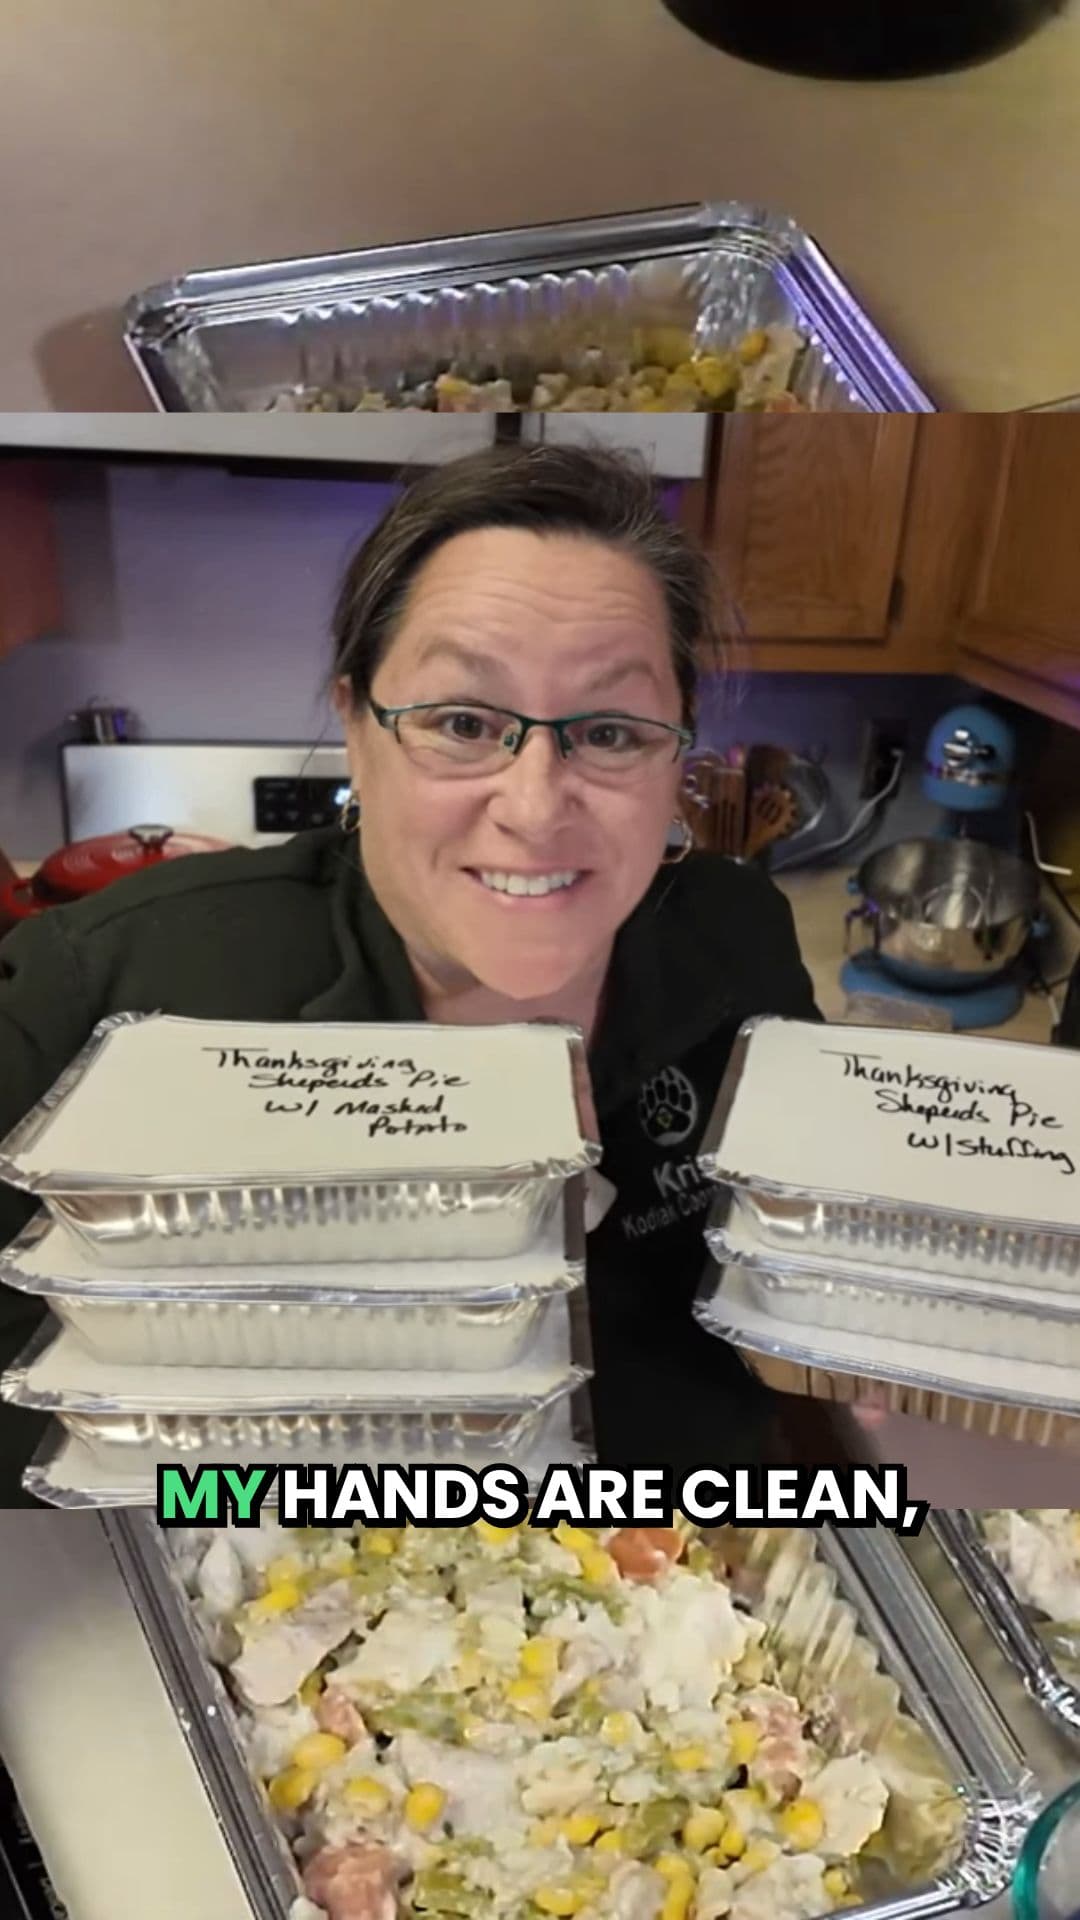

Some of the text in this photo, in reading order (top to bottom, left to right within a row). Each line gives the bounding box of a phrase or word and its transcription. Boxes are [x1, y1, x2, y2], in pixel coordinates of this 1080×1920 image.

[202, 1047, 417, 1077] Thanksgiving
[408, 1070, 470, 1088] Pie
[820, 1050, 1017, 1105] Thanksgiving
[367, 1115, 468, 1137] Potato
[1009, 1101, 1064, 1129] Pie
